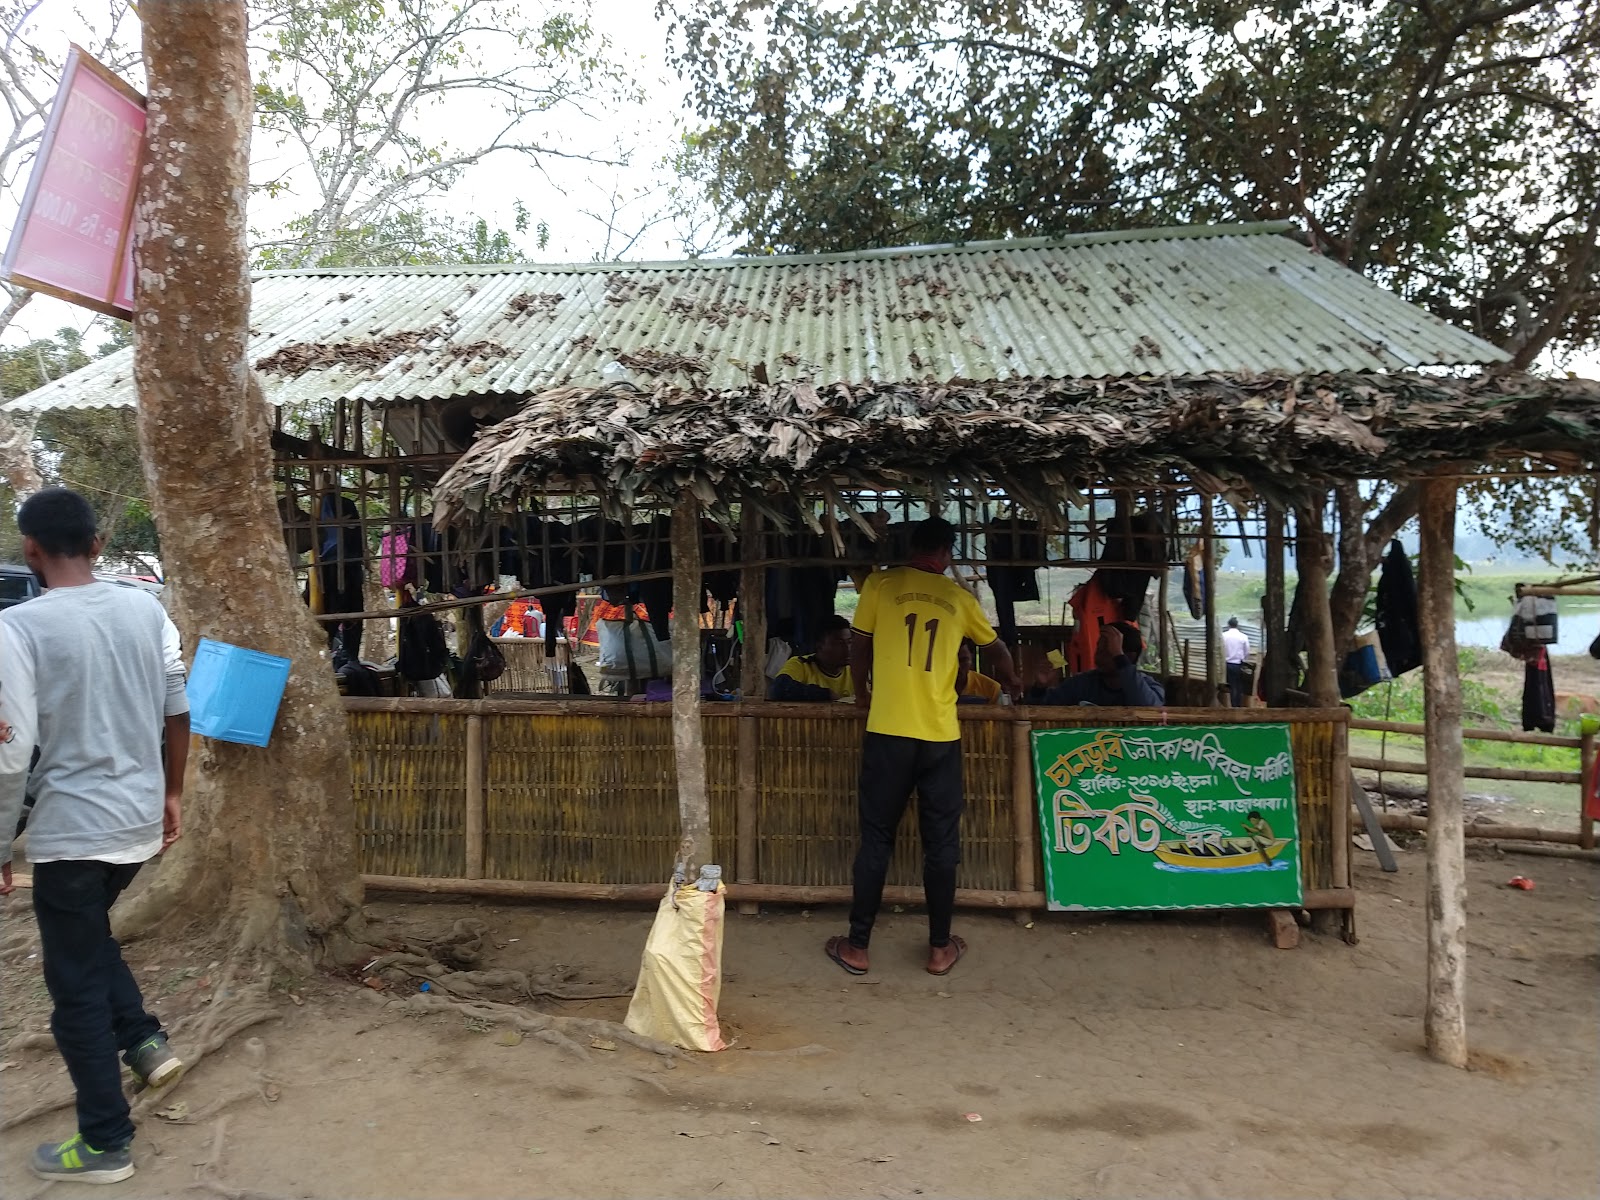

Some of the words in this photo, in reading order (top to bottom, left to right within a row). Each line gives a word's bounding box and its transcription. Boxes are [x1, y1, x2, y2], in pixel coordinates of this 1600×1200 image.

[905, 613, 939, 671] 11
[1044, 731, 1124, 788] চানডুবি
[1252, 751, 1292, 784] সমিতি
[1053, 789, 1172, 856] টিকট
